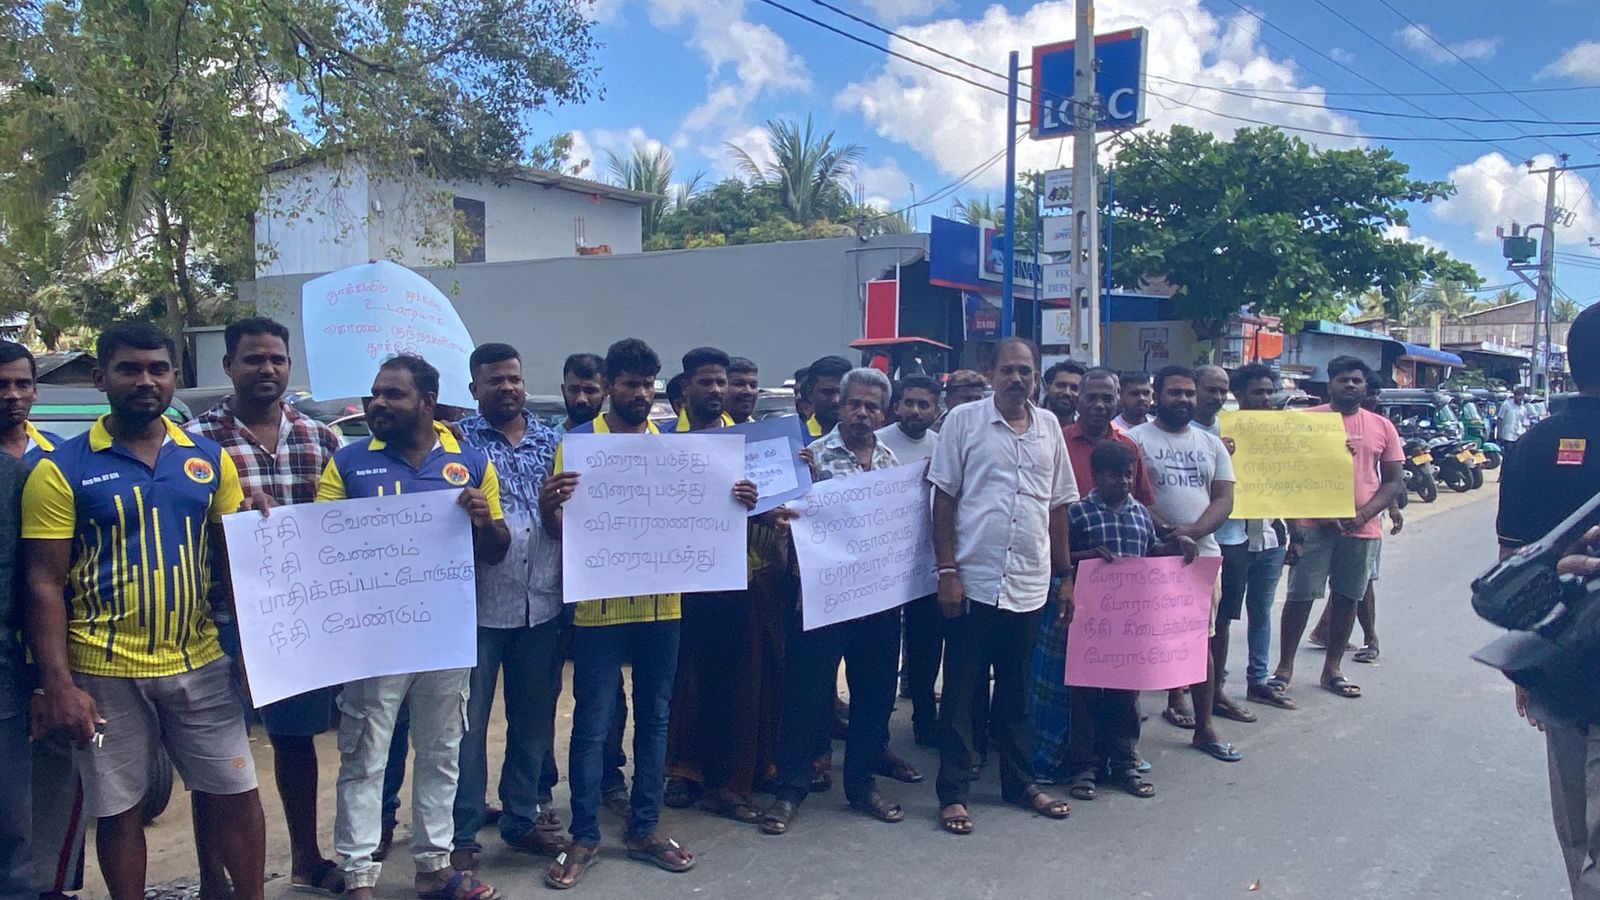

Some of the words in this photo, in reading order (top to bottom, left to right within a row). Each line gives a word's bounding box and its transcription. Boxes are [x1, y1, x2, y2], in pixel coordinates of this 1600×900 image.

[586, 450, 648, 477] விரைவு
[656, 450, 710, 474] படுத்து
[1155, 448, 1196, 463] JACK
[1197, 450, 1207, 463] &
[587, 482, 651, 506] விரைவு
[655, 479, 706, 505] படுத்து
[1158, 473, 1205, 488] JONES
[255, 516, 302, 552] நீதி
[321, 503, 432, 535] வேண்டும்
[584, 511, 730, 540] விசாரணையை
[259, 552, 302, 587] நீதி
[319, 538, 420, 566] வேண்டும்
[585, 545, 716, 574] விரைவுபடுத்து
[269, 618, 311, 655] நீதி
[322, 601, 432, 634] வேண்டும்
